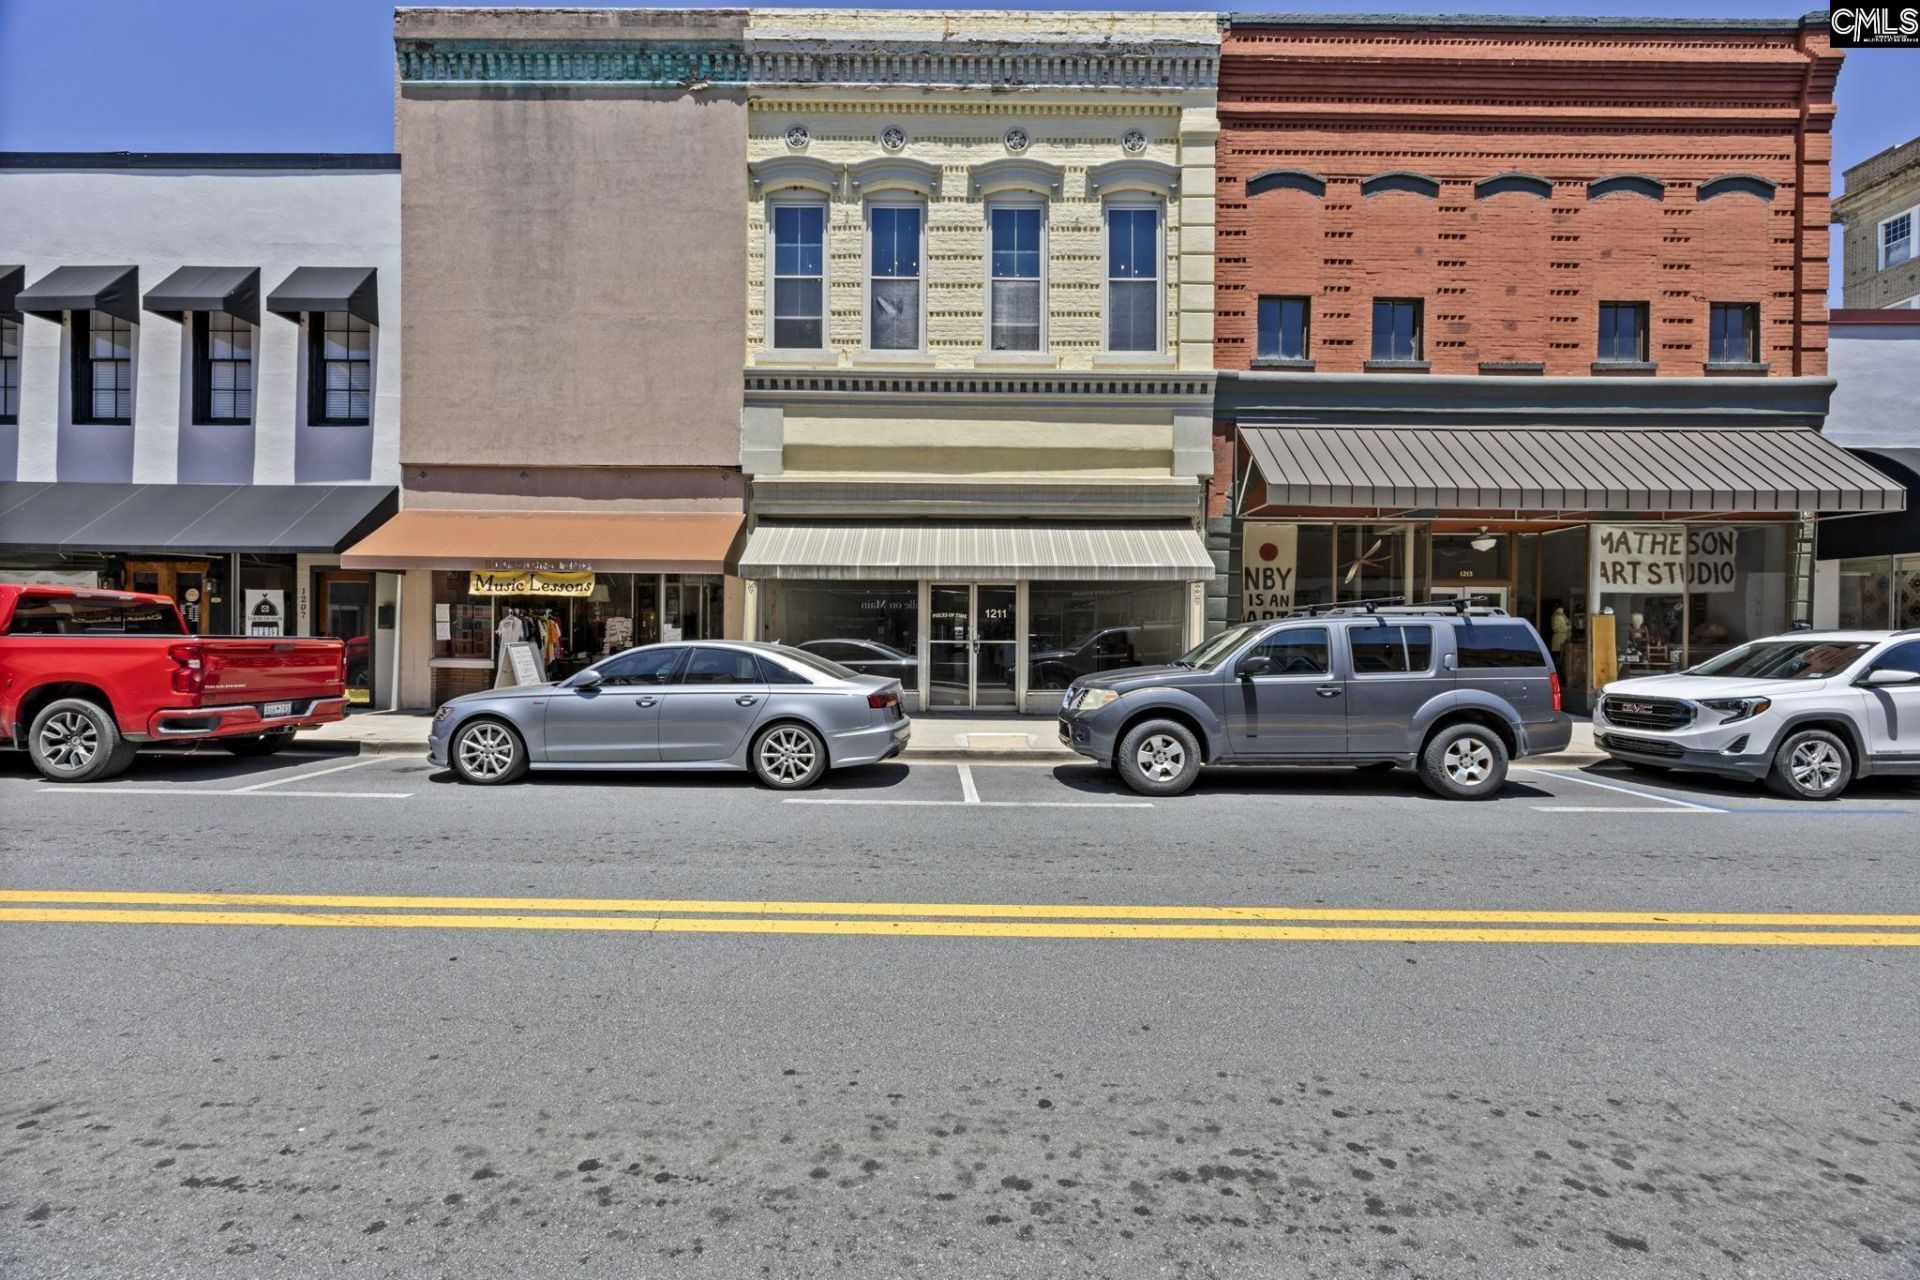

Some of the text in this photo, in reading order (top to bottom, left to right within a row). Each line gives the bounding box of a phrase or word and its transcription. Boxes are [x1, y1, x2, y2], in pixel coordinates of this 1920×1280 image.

[1601, 531, 1734, 555] MATHESON
[1244, 566, 1292, 590] NBY
[1600, 561, 1734, 584] ART STUDIO
[474, 573, 592, 592] Music Lessons
[1249, 593, 1289, 607] IS AN
[985, 609, 1007, 618] 1211
[1621, 703, 1653, 714] GMC
